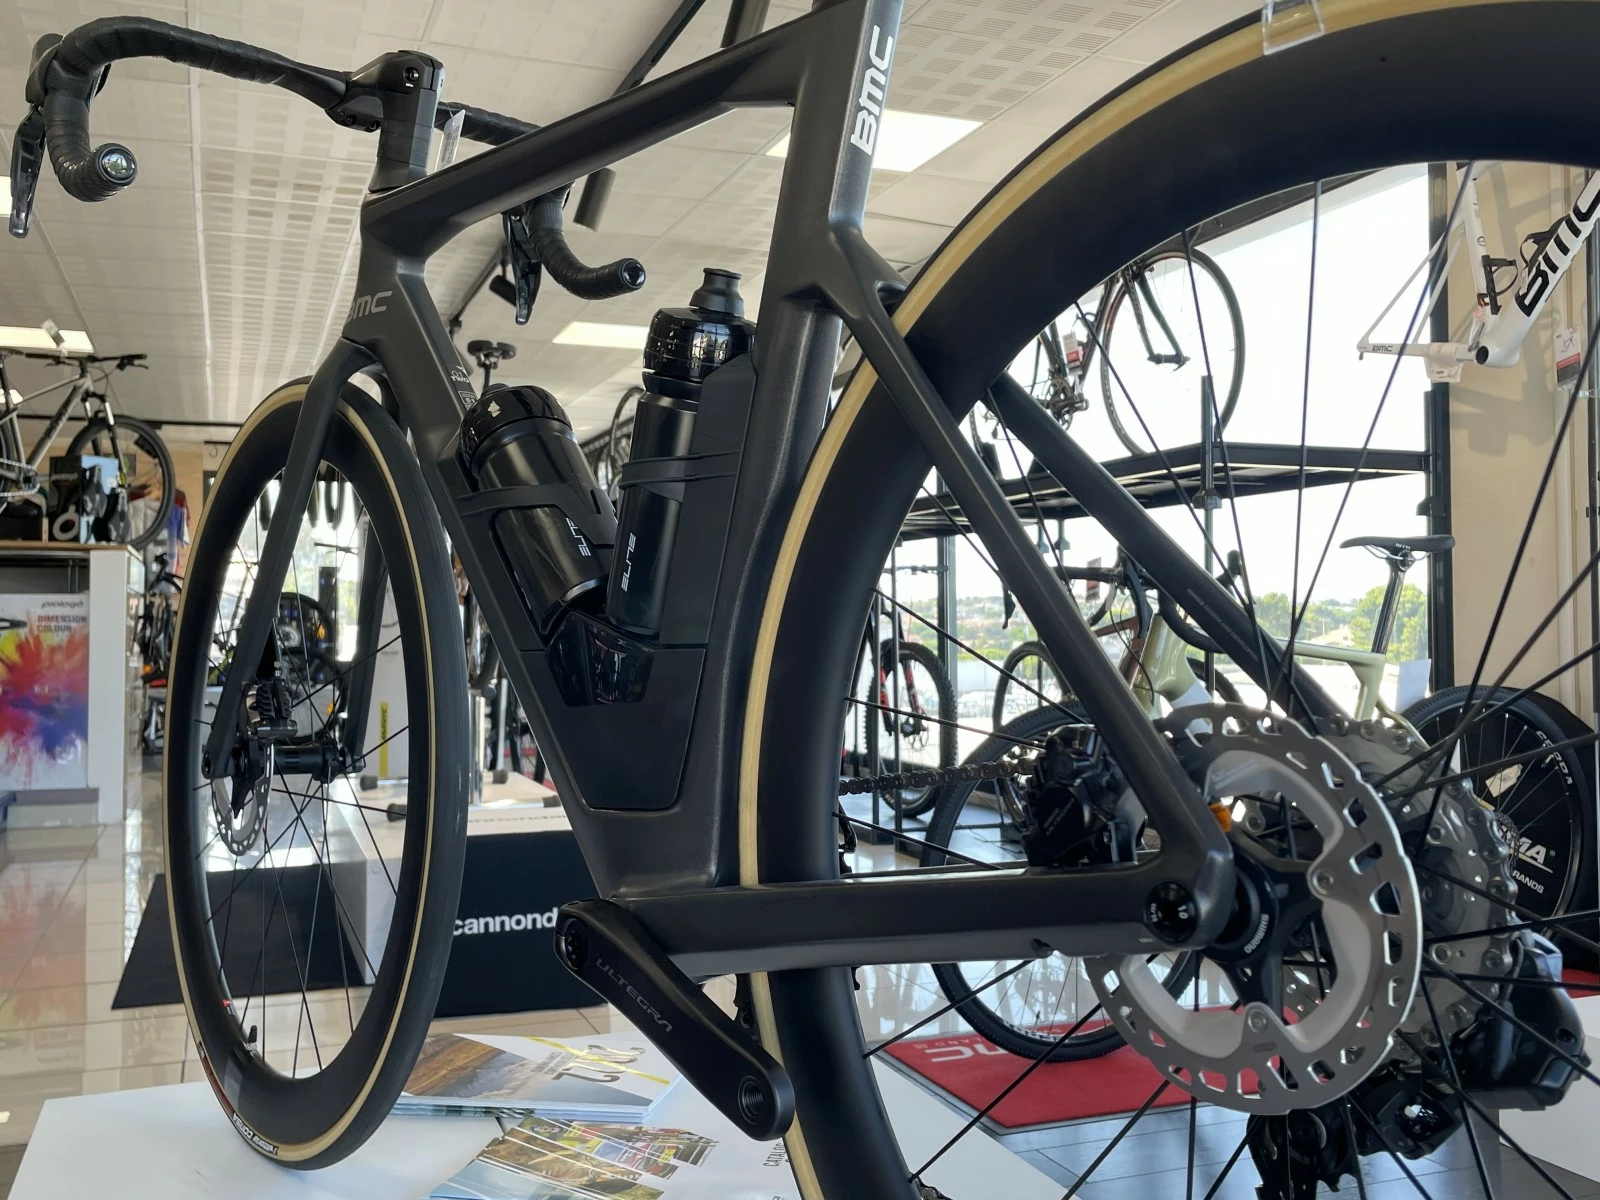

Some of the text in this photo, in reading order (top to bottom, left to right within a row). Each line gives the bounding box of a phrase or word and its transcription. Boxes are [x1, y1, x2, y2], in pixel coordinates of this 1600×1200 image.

[850, 24, 893, 156] BMC
[1515, 185, 1600, 318] BMC
[621, 532, 637, 592] ELITE
[37, 615, 87, 623] DIMENSION
[1512, 869, 1545, 894] RANDS
[453, 906, 558, 936] cannond
[596, 959, 673, 1032] ULTEGRA
